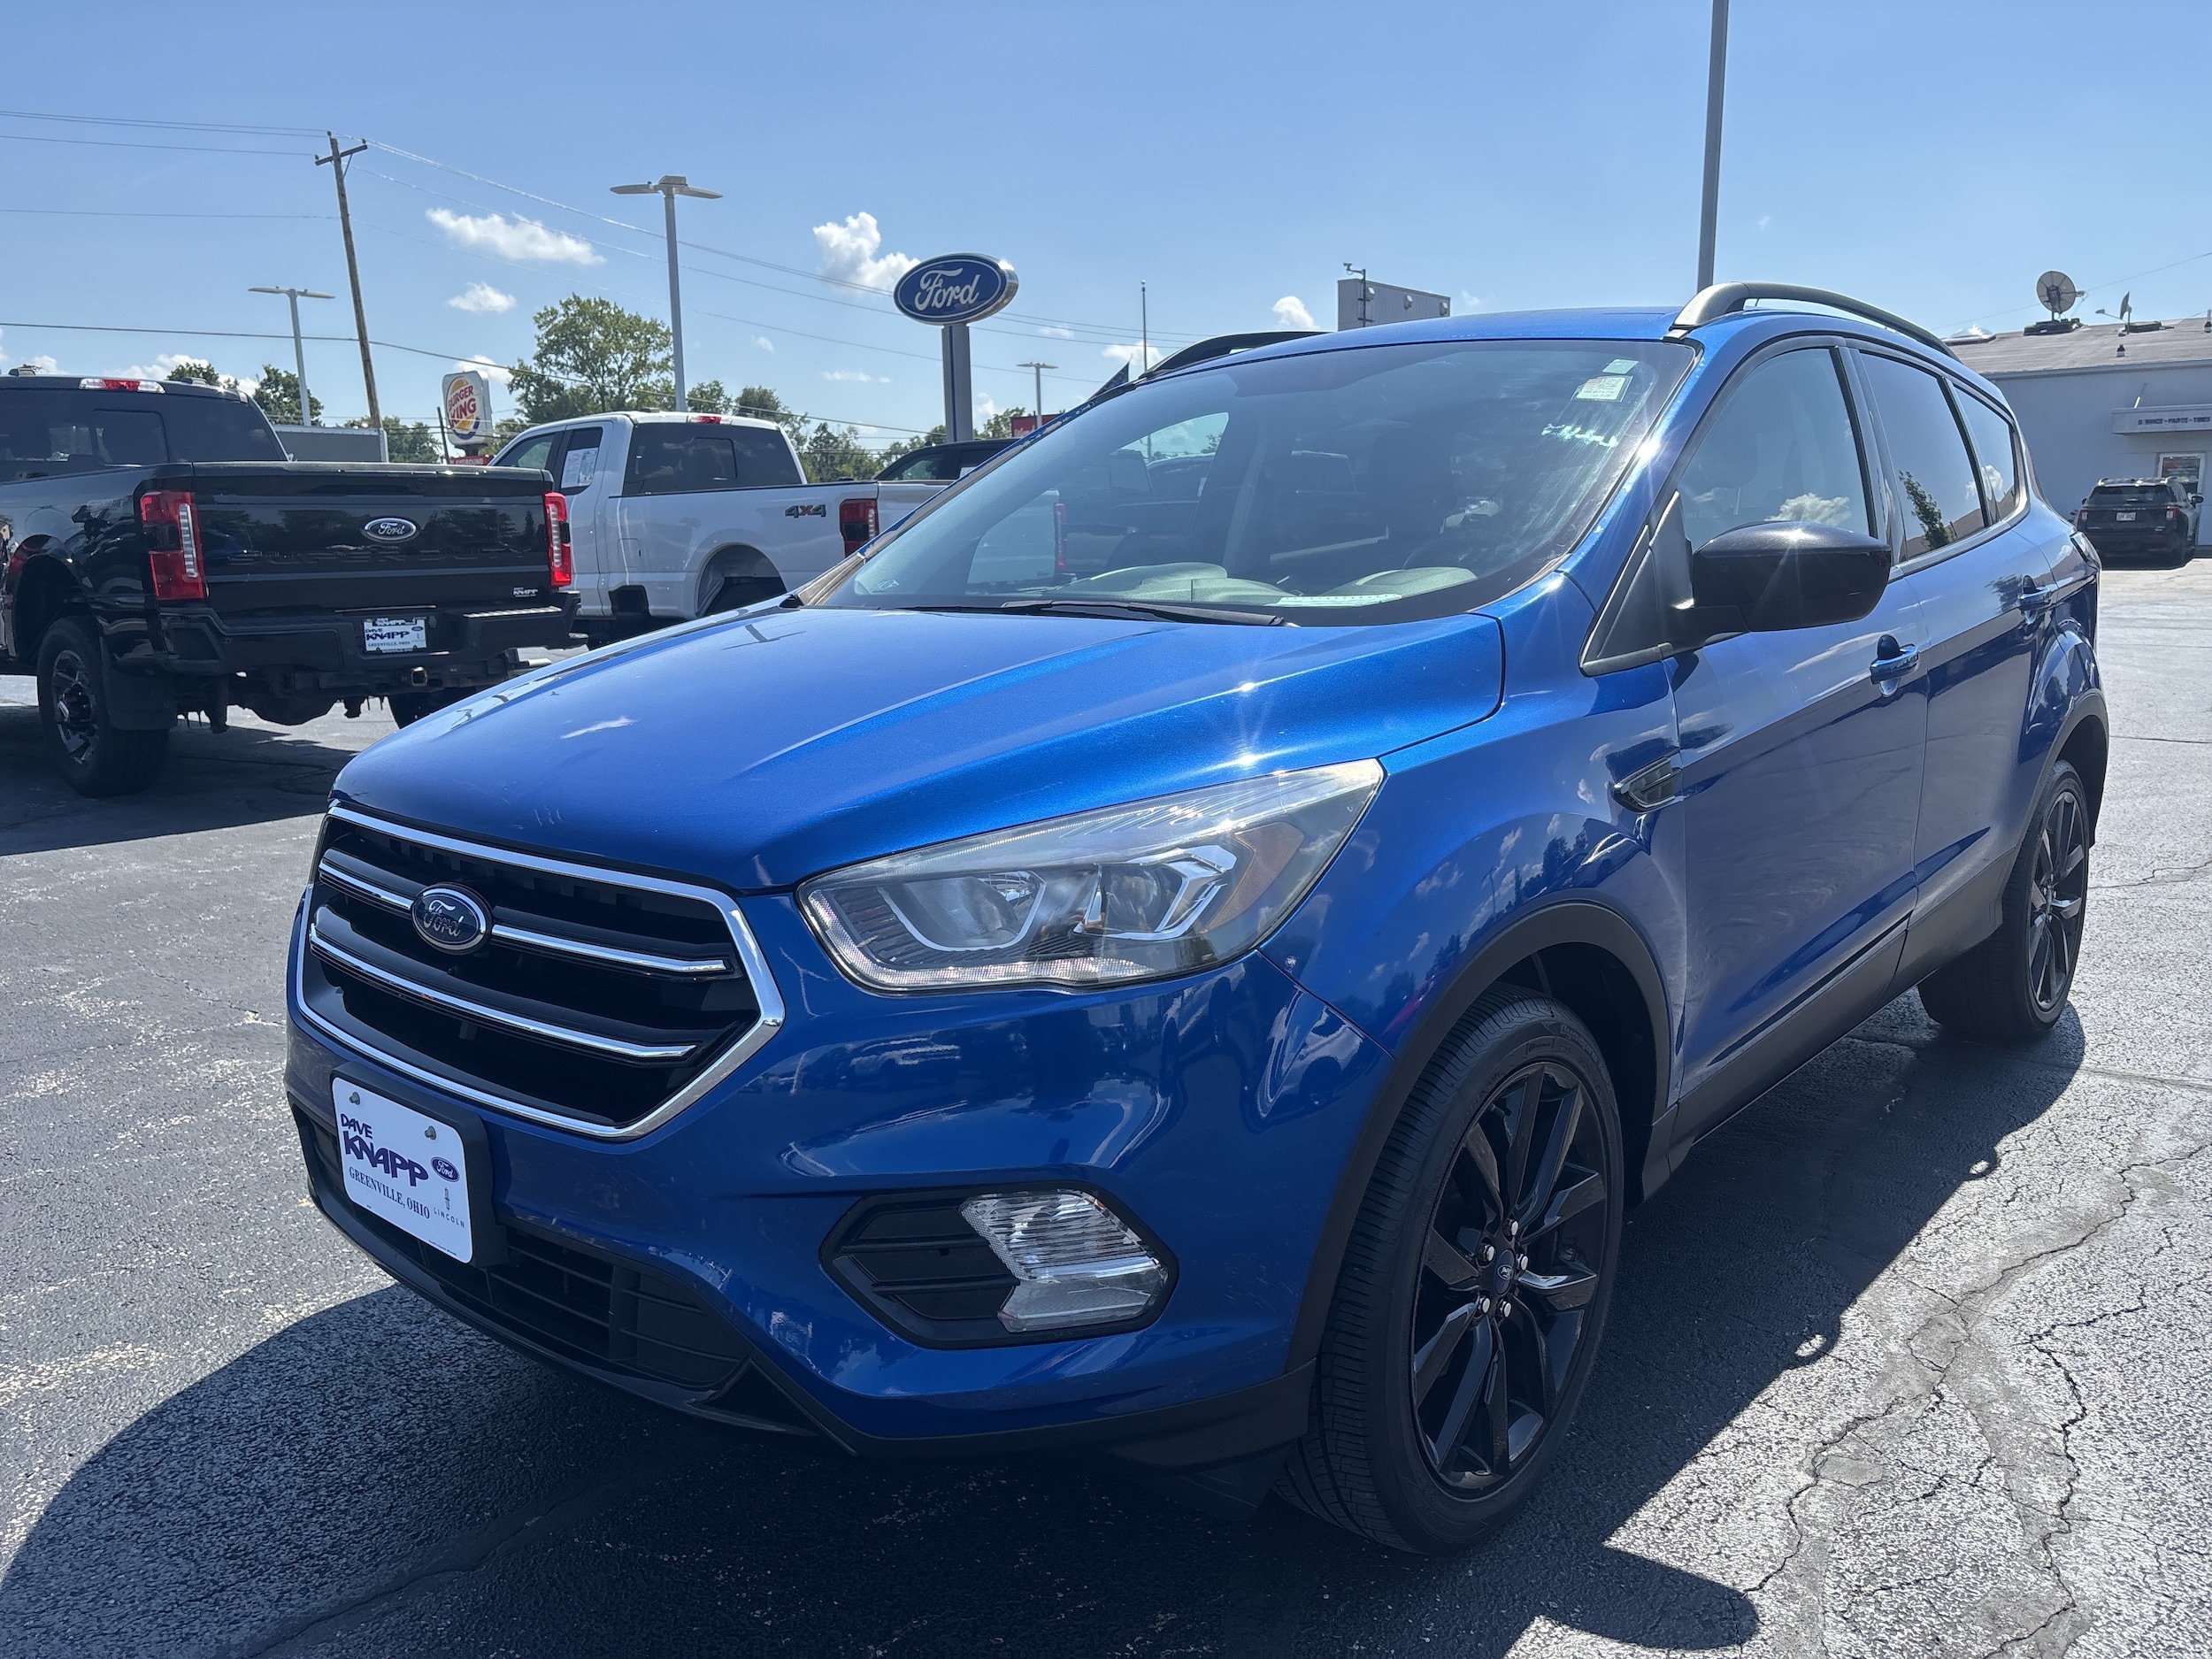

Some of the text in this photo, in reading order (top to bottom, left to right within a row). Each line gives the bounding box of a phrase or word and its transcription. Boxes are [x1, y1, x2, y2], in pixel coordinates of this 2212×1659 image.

[915, 267, 980, 311] Ford
[448, 385, 474, 411] BURGER
[450, 397, 477, 428] KING
[378, 522, 404, 534] Ford
[366, 631, 410, 641] KNAPP
[423, 899, 465, 936] Ford
[341, 1113, 373, 1140] DAVE
[343, 1131, 428, 1187] KNAPP
[436, 1159, 454, 1179] Ford
[349, 1166, 430, 1219] GREENVILLE, OHIO
[433, 1207, 465, 1228] LINCOLN
